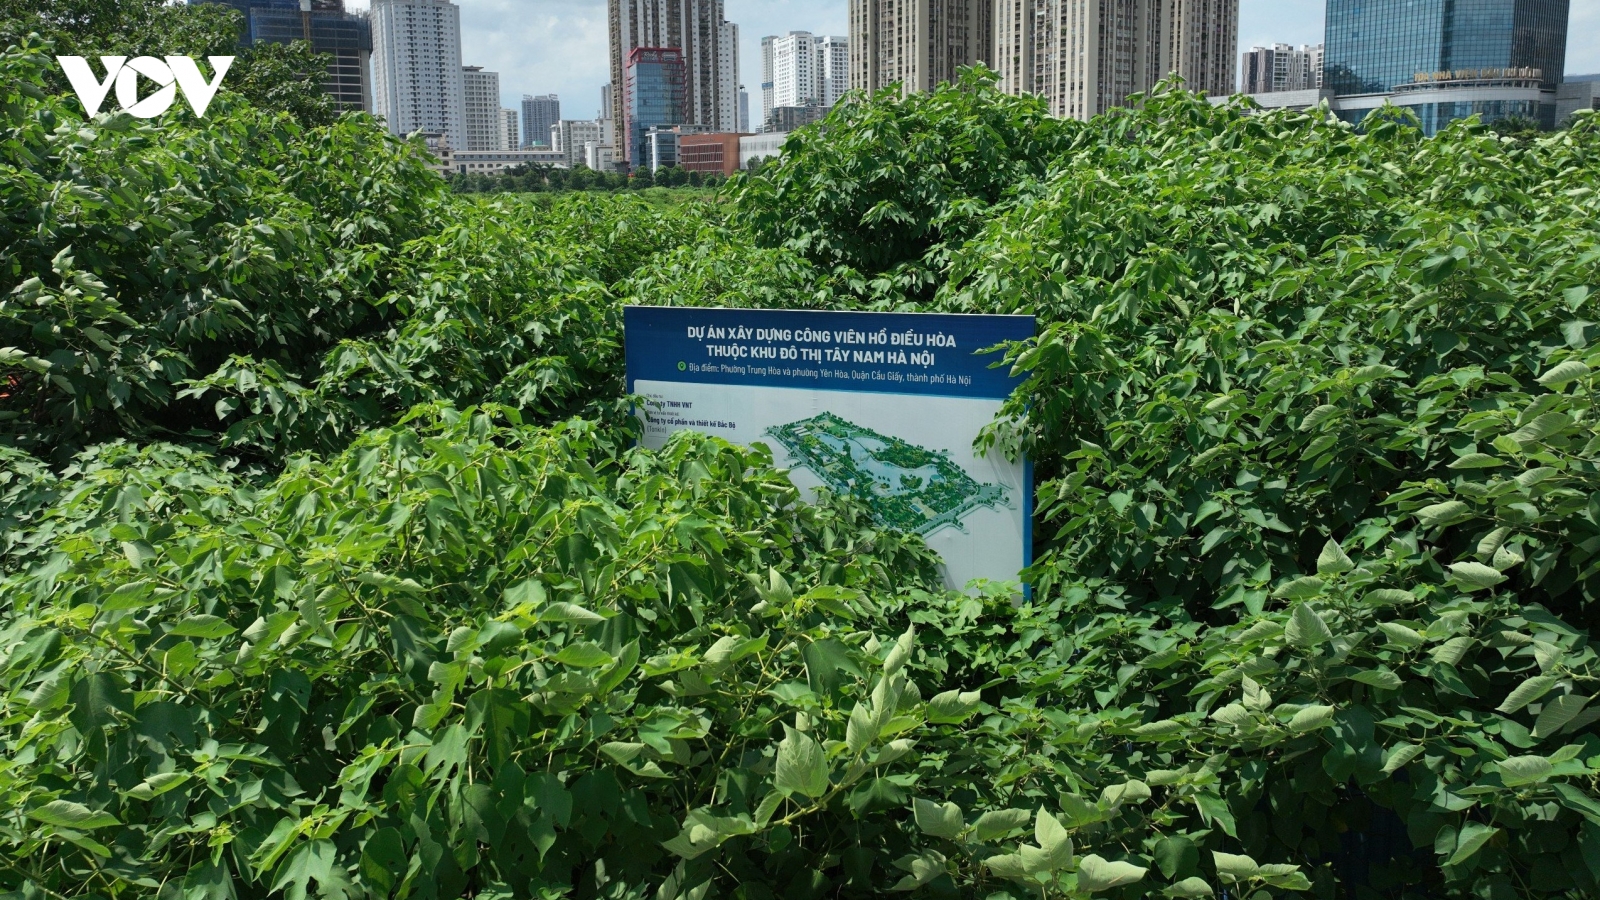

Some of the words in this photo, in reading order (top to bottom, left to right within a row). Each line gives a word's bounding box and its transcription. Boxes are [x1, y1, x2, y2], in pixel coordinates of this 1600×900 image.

[687, 325, 705, 342] DỰ
[707, 324, 725, 339] ÁN
[728, 325, 753, 340] XÂY
[756, 327, 791, 344] DỰNG
[794, 327, 830, 343] CÔNG
[833, 328, 865, 344] VIÊN
[868, 327, 887, 345] HỒ
[890, 328, 923, 346] ĐIỀU
[926, 331, 957, 347] HÒA
[706, 342, 748, 360] THUỘC
[750, 346, 777, 359] KHU
[779, 345, 798, 360] ĐÔ
[800, 348, 822, 364] THỊ
[824, 347, 851, 362] TÂY
[853, 350, 885, 364] NAM
[887, 349, 907, 365] HÀ
[910, 350, 935, 369] NỘI
[689, 362, 700, 374] Địa
[701, 362, 719, 373] điểm:
[720, 364, 746, 376] Phường
[747, 365, 767, 376] Trung
[768, 365, 781, 375] Hòa
[782, 367, 791, 376] và
[792, 366, 818, 379] phường
[820, 368, 833, 378] Yên
[834, 370, 850, 379] Hòa,
[851, 370, 870, 382] Quận
[871, 370, 886, 381] Cầu
[887, 371, 905, 383] Giấy,
[906, 372, 928, 383] thành
[930, 373, 945, 385] phố
[946, 375, 957, 384] Hà
[958, 375, 972, 387] Nội
[666, 400, 681, 408] TNHH
[682, 401, 693, 409] VNT
[660, 418, 667, 426] ty
